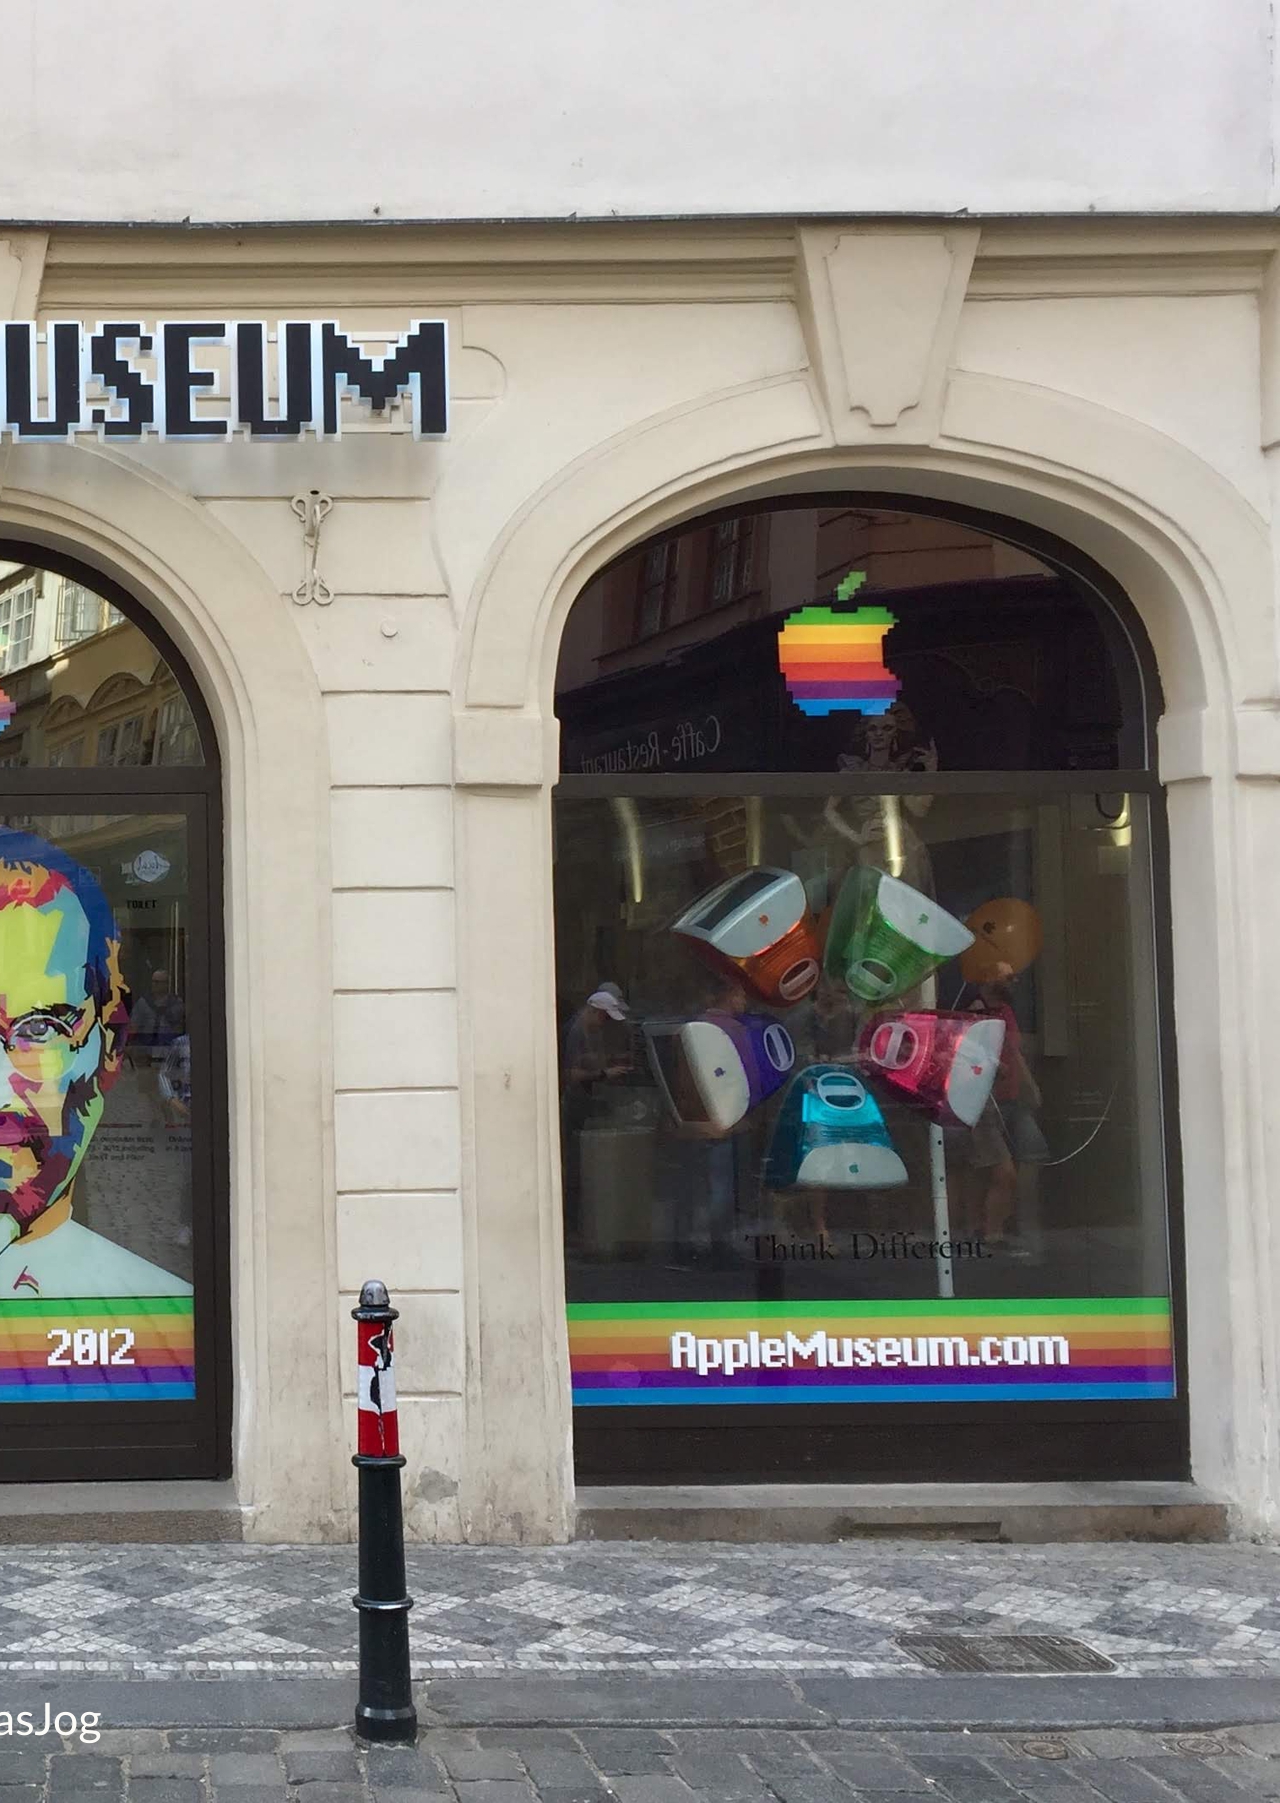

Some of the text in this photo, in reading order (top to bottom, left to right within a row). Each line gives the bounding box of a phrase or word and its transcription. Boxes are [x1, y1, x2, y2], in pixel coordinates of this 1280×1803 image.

[744, 1231, 994, 1261] Think Different.
[47, 1328, 135, 1366] 2012
[670, 1330, 1070, 1376] AppleMuseum.com
